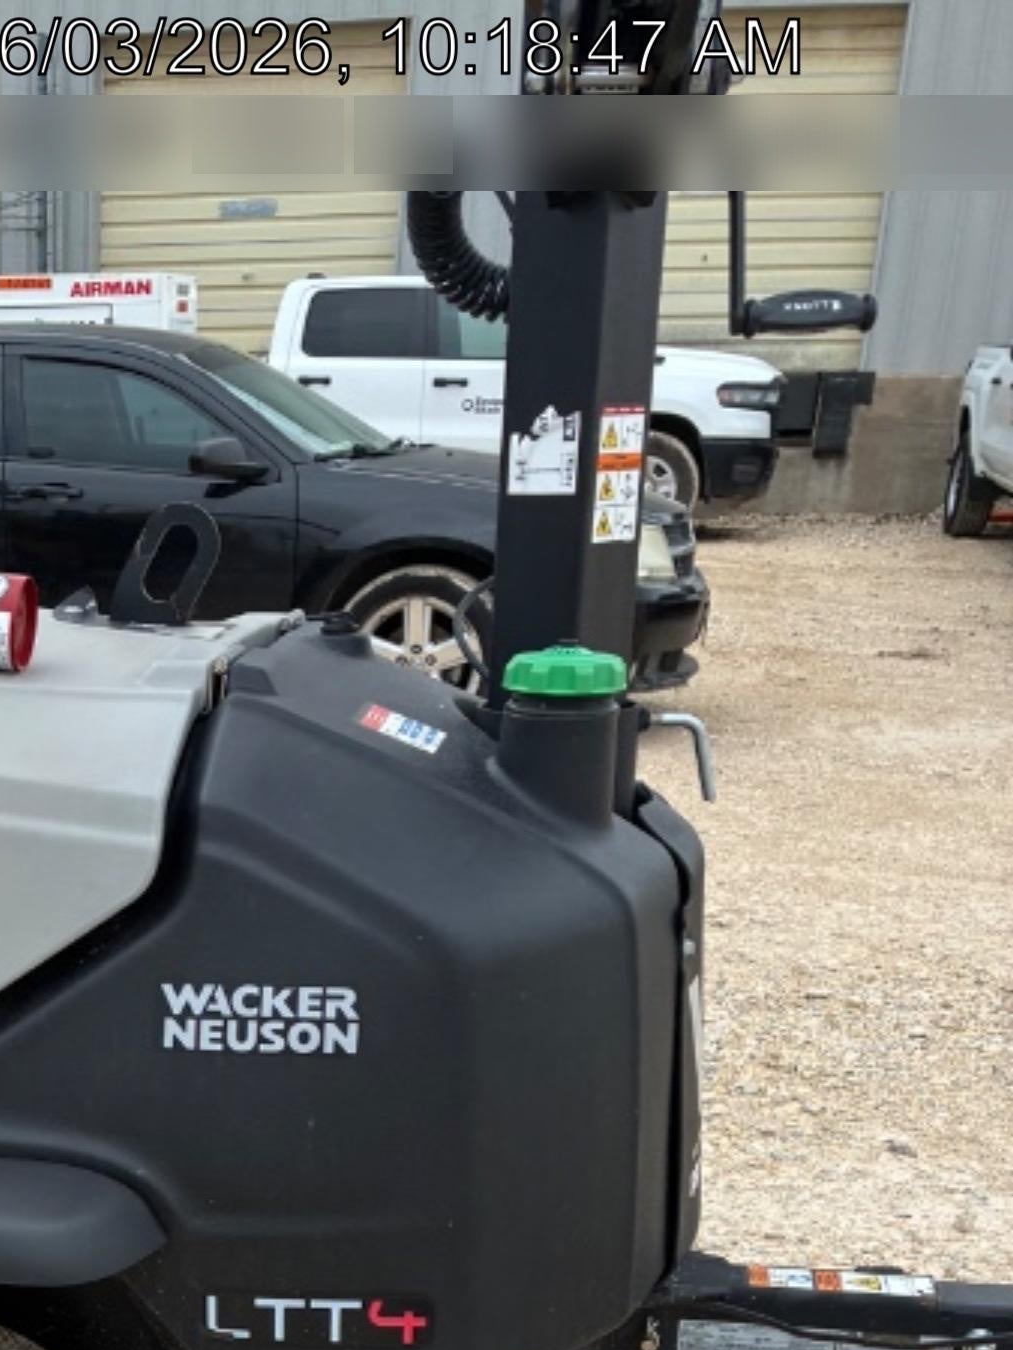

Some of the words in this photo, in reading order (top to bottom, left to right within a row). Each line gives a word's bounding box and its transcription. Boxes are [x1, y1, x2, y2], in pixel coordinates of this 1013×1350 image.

[70, 280, 152, 298] AIRMAN
[161, 983, 360, 1021] WACKER
[162, 1018, 360, 1054] NEUSON
